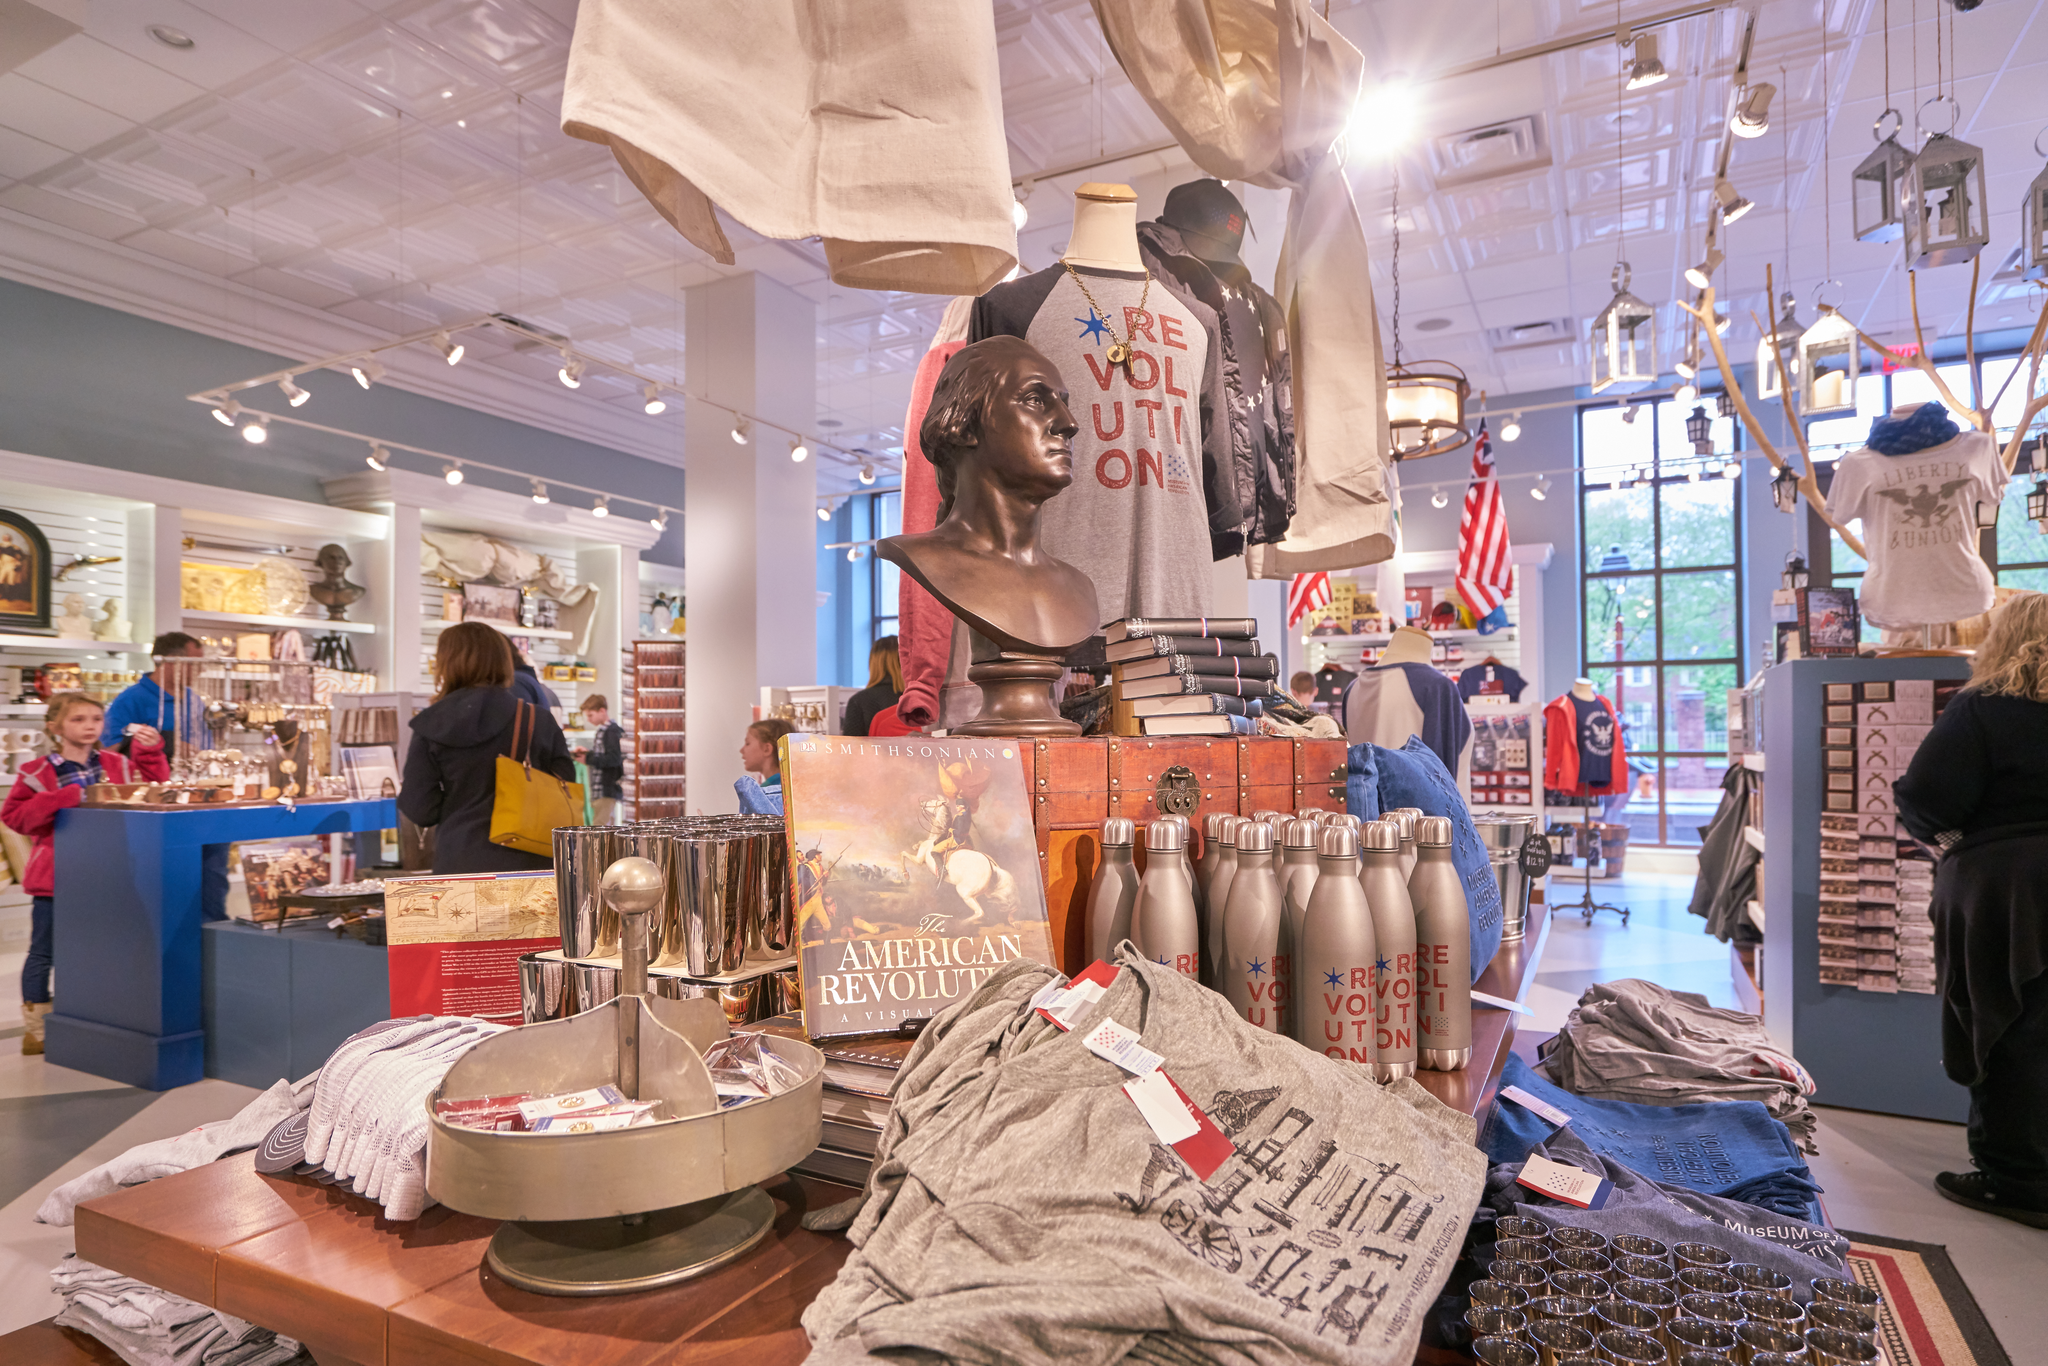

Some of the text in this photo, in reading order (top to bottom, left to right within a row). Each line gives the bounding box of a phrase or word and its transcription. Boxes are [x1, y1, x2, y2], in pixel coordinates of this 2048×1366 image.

[1123, 306, 1188, 351] RE
[1083, 350, 1188, 399] VOL
[1092, 398, 1182, 445] UTI
[1095, 448, 1164, 489] ON
[1884, 462, 1966, 487] LIBERTY
[1890, 521, 1963, 549] & UNION
[825, 743, 995, 759] SMITHSONIAN
[914, 913, 953, 937] The
[837, 934, 1022, 971] AMERICAN
[817, 966, 997, 1005] REVOLUT
[1417, 966, 1448, 989] OL
[841, 1007, 936, 1022] A VISUAL
[1323, 993, 1375, 1016] VOL
[1417, 990, 1444, 1012] TI
[836, 1050, 903, 1064] HISTOR
[1675, 1141, 1716, 1185] AMERICAN
[1697, 1133, 1740, 1184] REVOLUTION
[1724, 1219, 1808, 1240] MUSEUM
[1385, 1303, 1412, 1338] MUSEUM
[1411, 1250, 1438, 1294] AMERICAN
[1433, 1219, 1460, 1259] REVOLUTION
